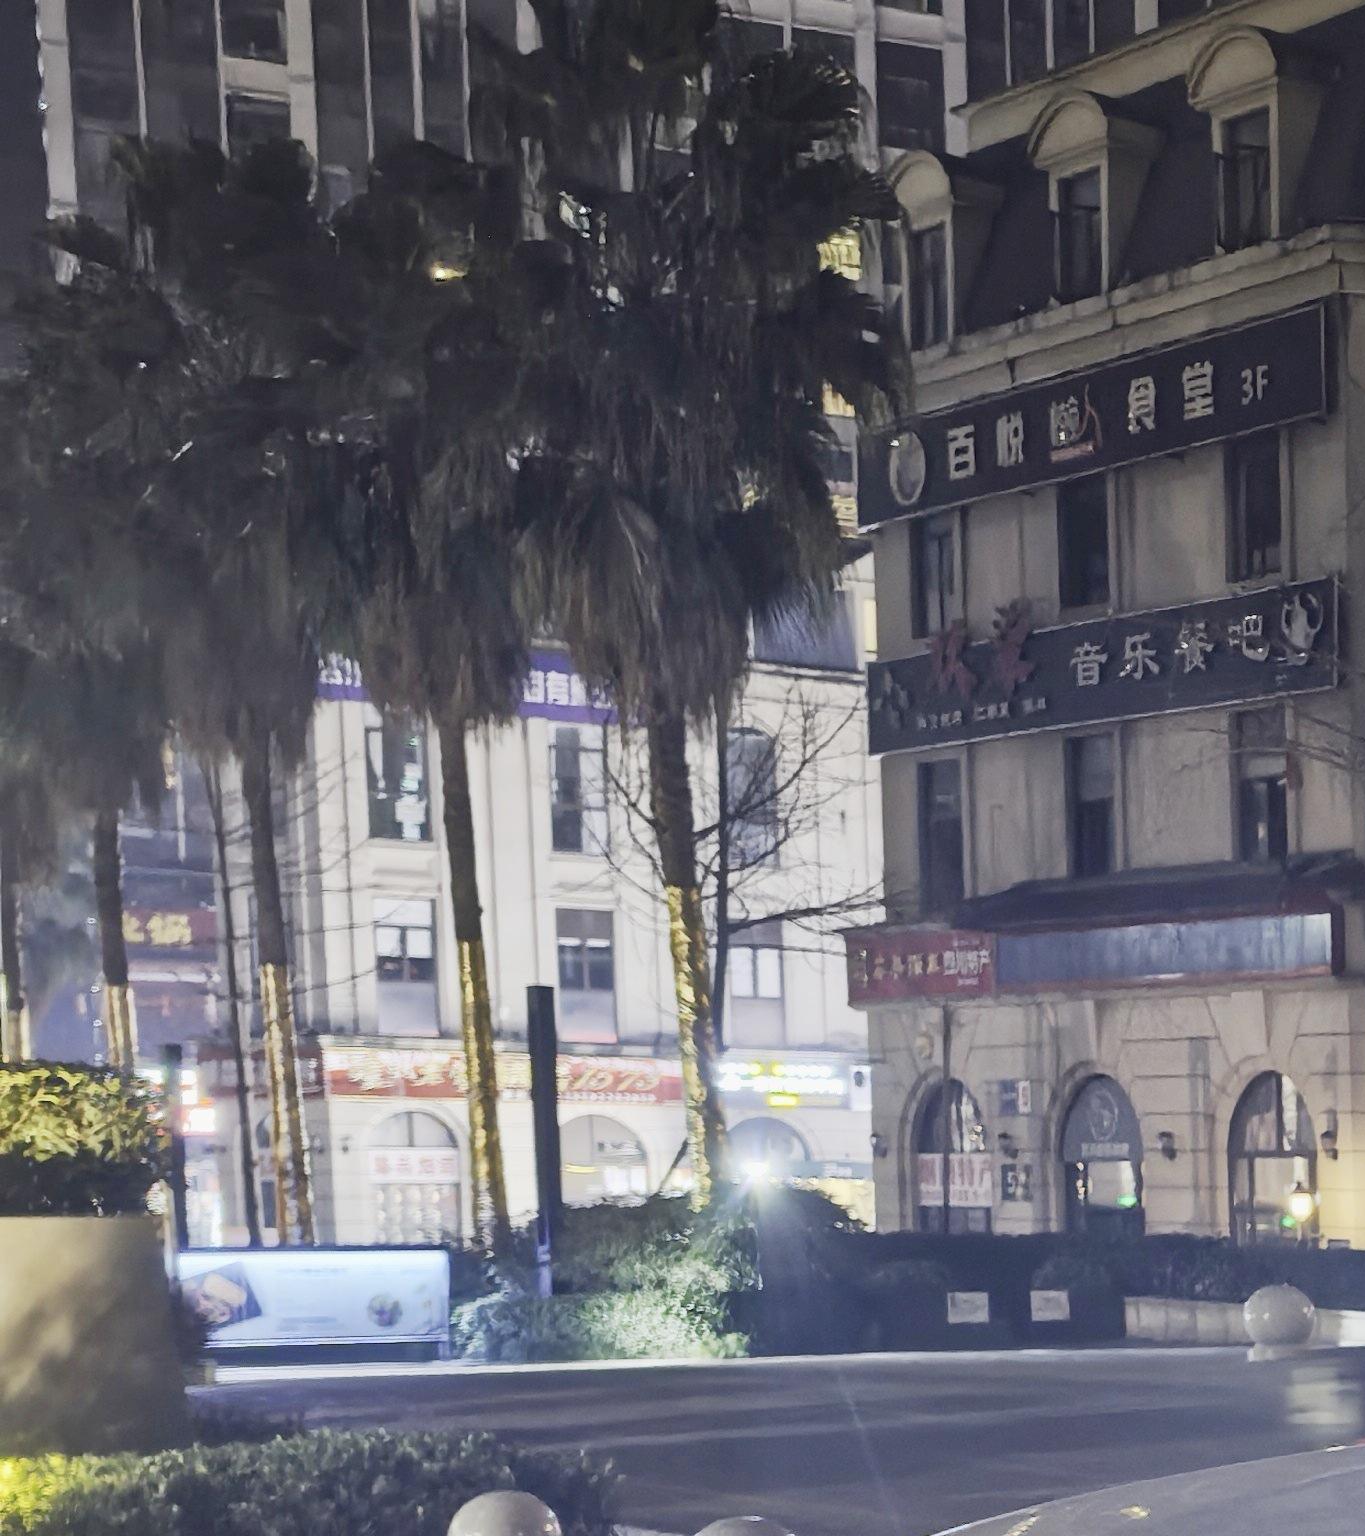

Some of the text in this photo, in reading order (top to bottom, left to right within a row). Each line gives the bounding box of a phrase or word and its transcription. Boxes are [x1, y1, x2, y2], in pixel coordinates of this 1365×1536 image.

[1240, 364, 1269, 406] 3F
[1069, 612, 1271, 689] 音乐餐吧
